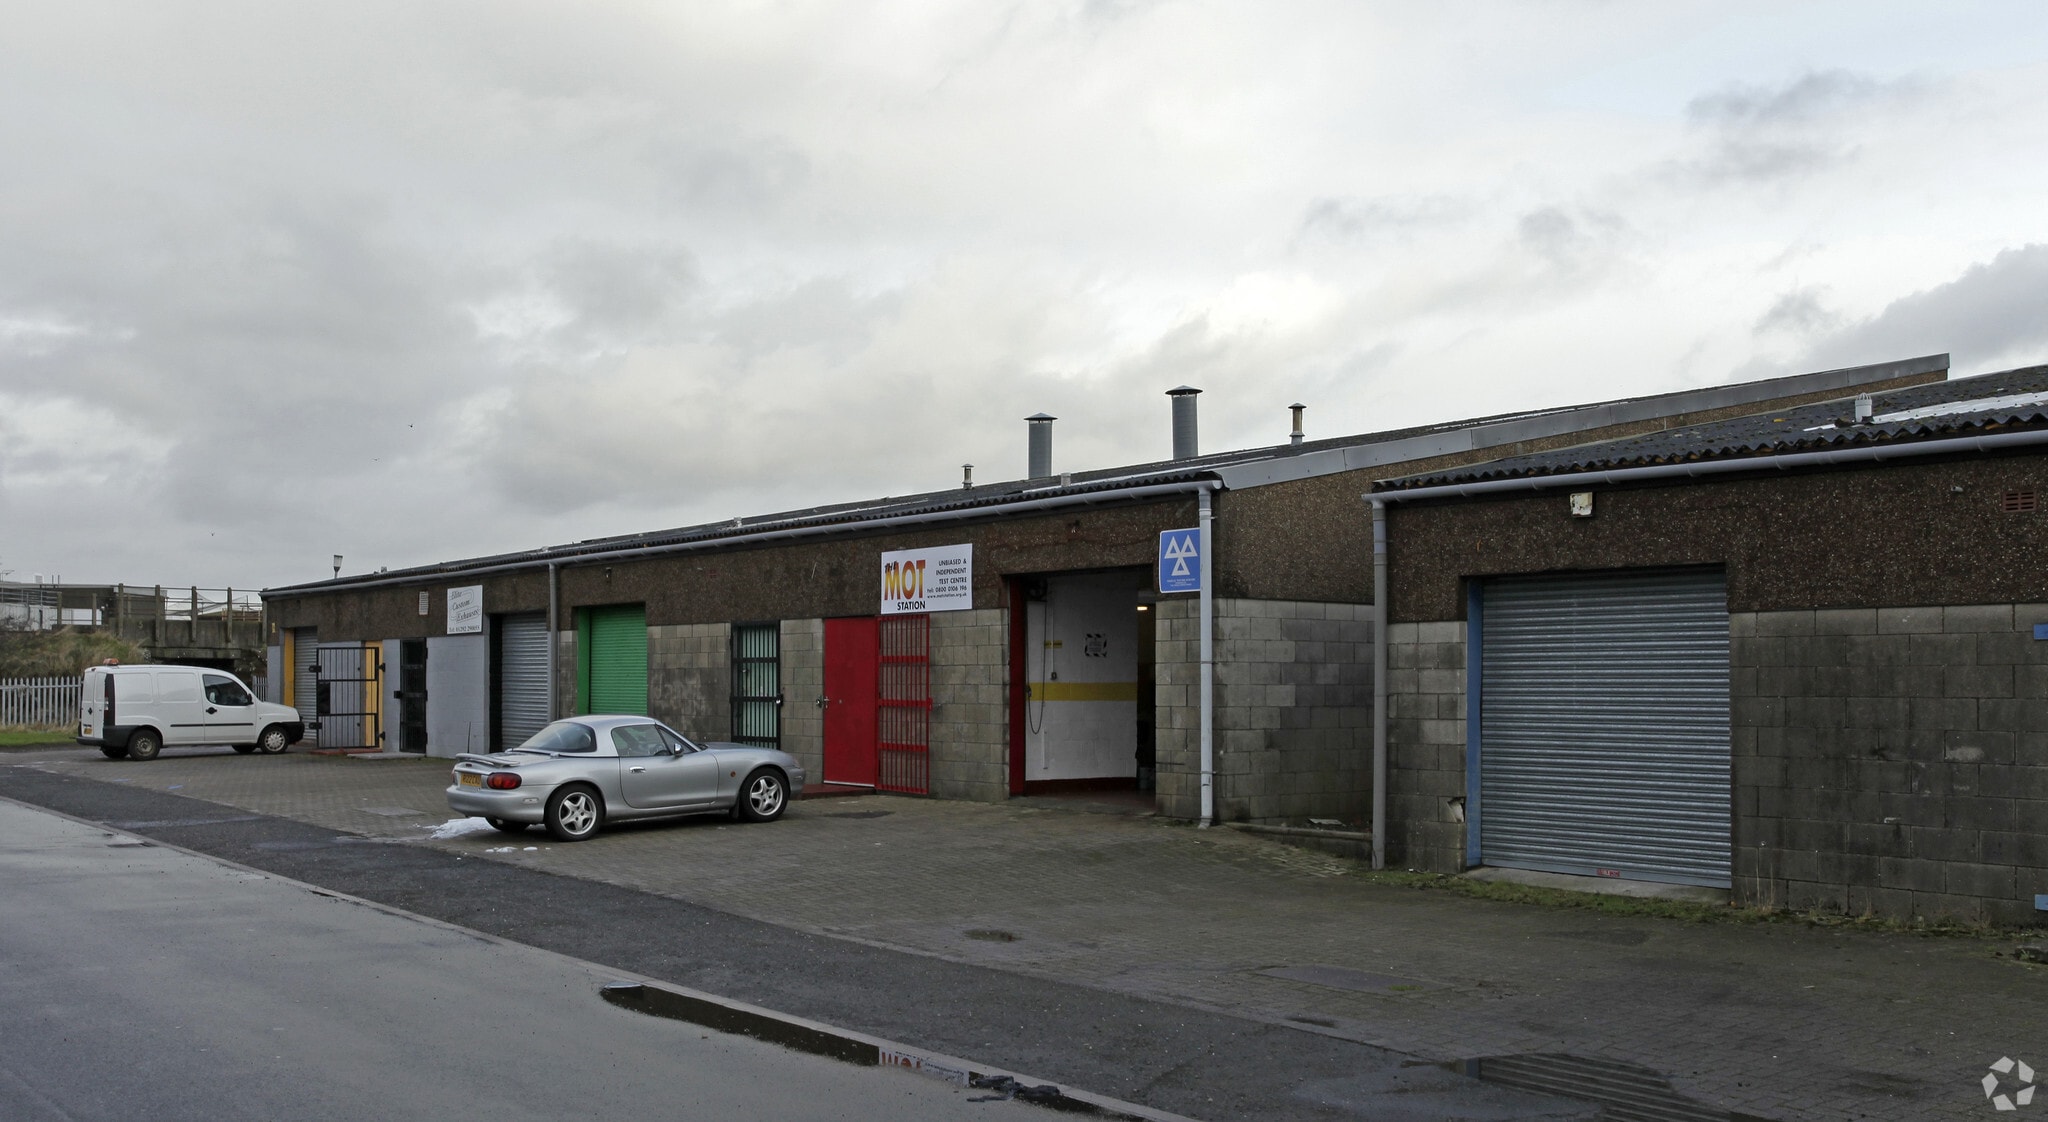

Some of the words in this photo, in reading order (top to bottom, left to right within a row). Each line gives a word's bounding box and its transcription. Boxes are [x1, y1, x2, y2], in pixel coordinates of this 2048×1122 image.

[935, 567, 967, 575] INDEPENDENT
[884, 560, 926, 600] MOT
[950, 576, 967, 584] CENTRE
[897, 601, 926, 610] STATION
